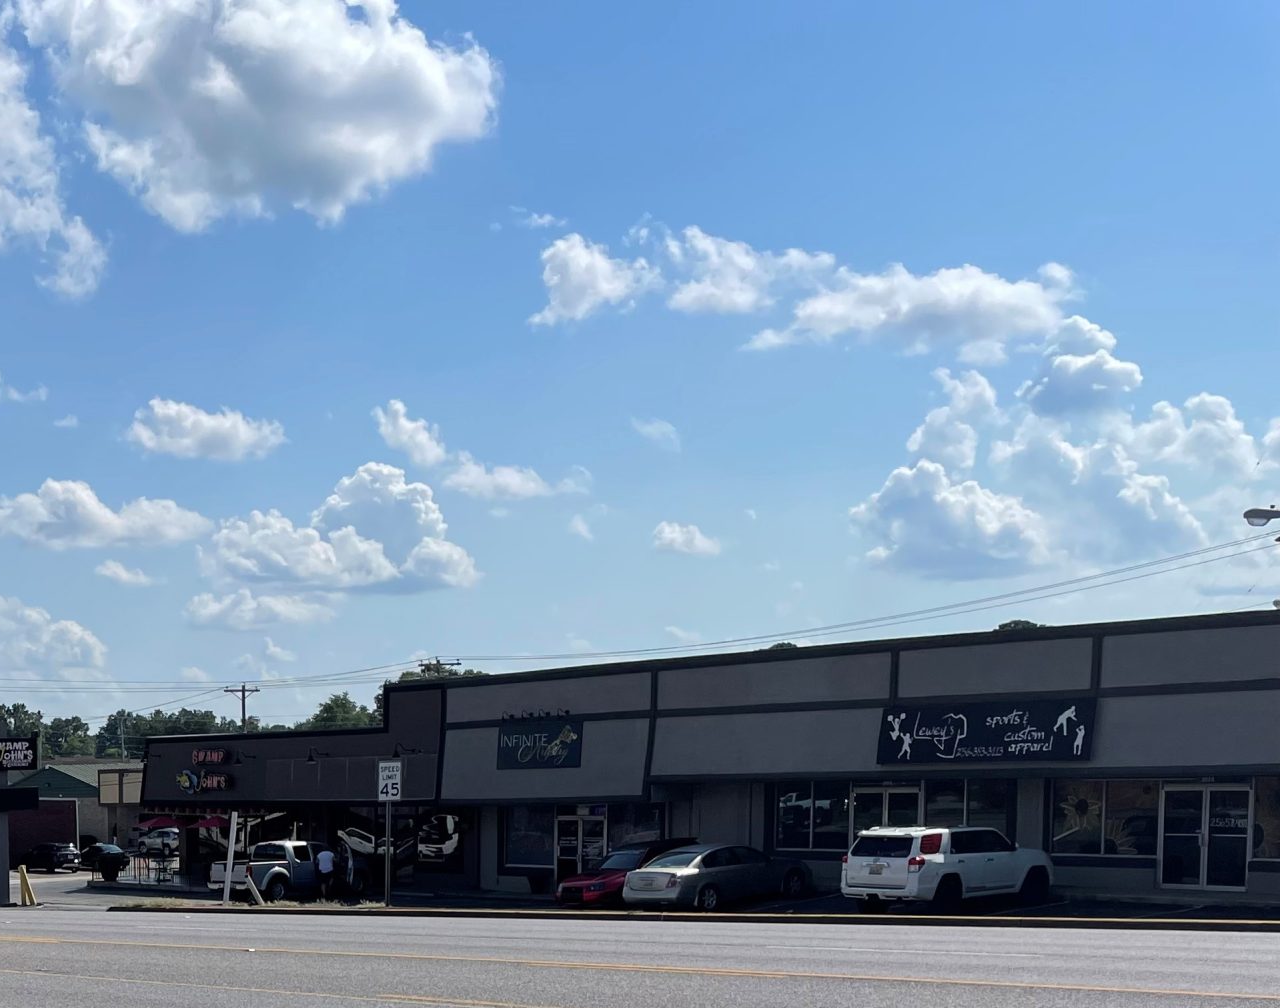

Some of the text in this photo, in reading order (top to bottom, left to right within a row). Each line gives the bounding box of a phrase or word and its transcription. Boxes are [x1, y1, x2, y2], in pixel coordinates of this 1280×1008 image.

[985, 709, 1023, 728] sports
[500, 732, 549, 748] INFINITE
[1004, 725, 1045, 741] custom
[1008, 735, 1053, 755] apparel
[192, 749, 225, 764] SWAMP
[380, 782, 399, 797] 45
